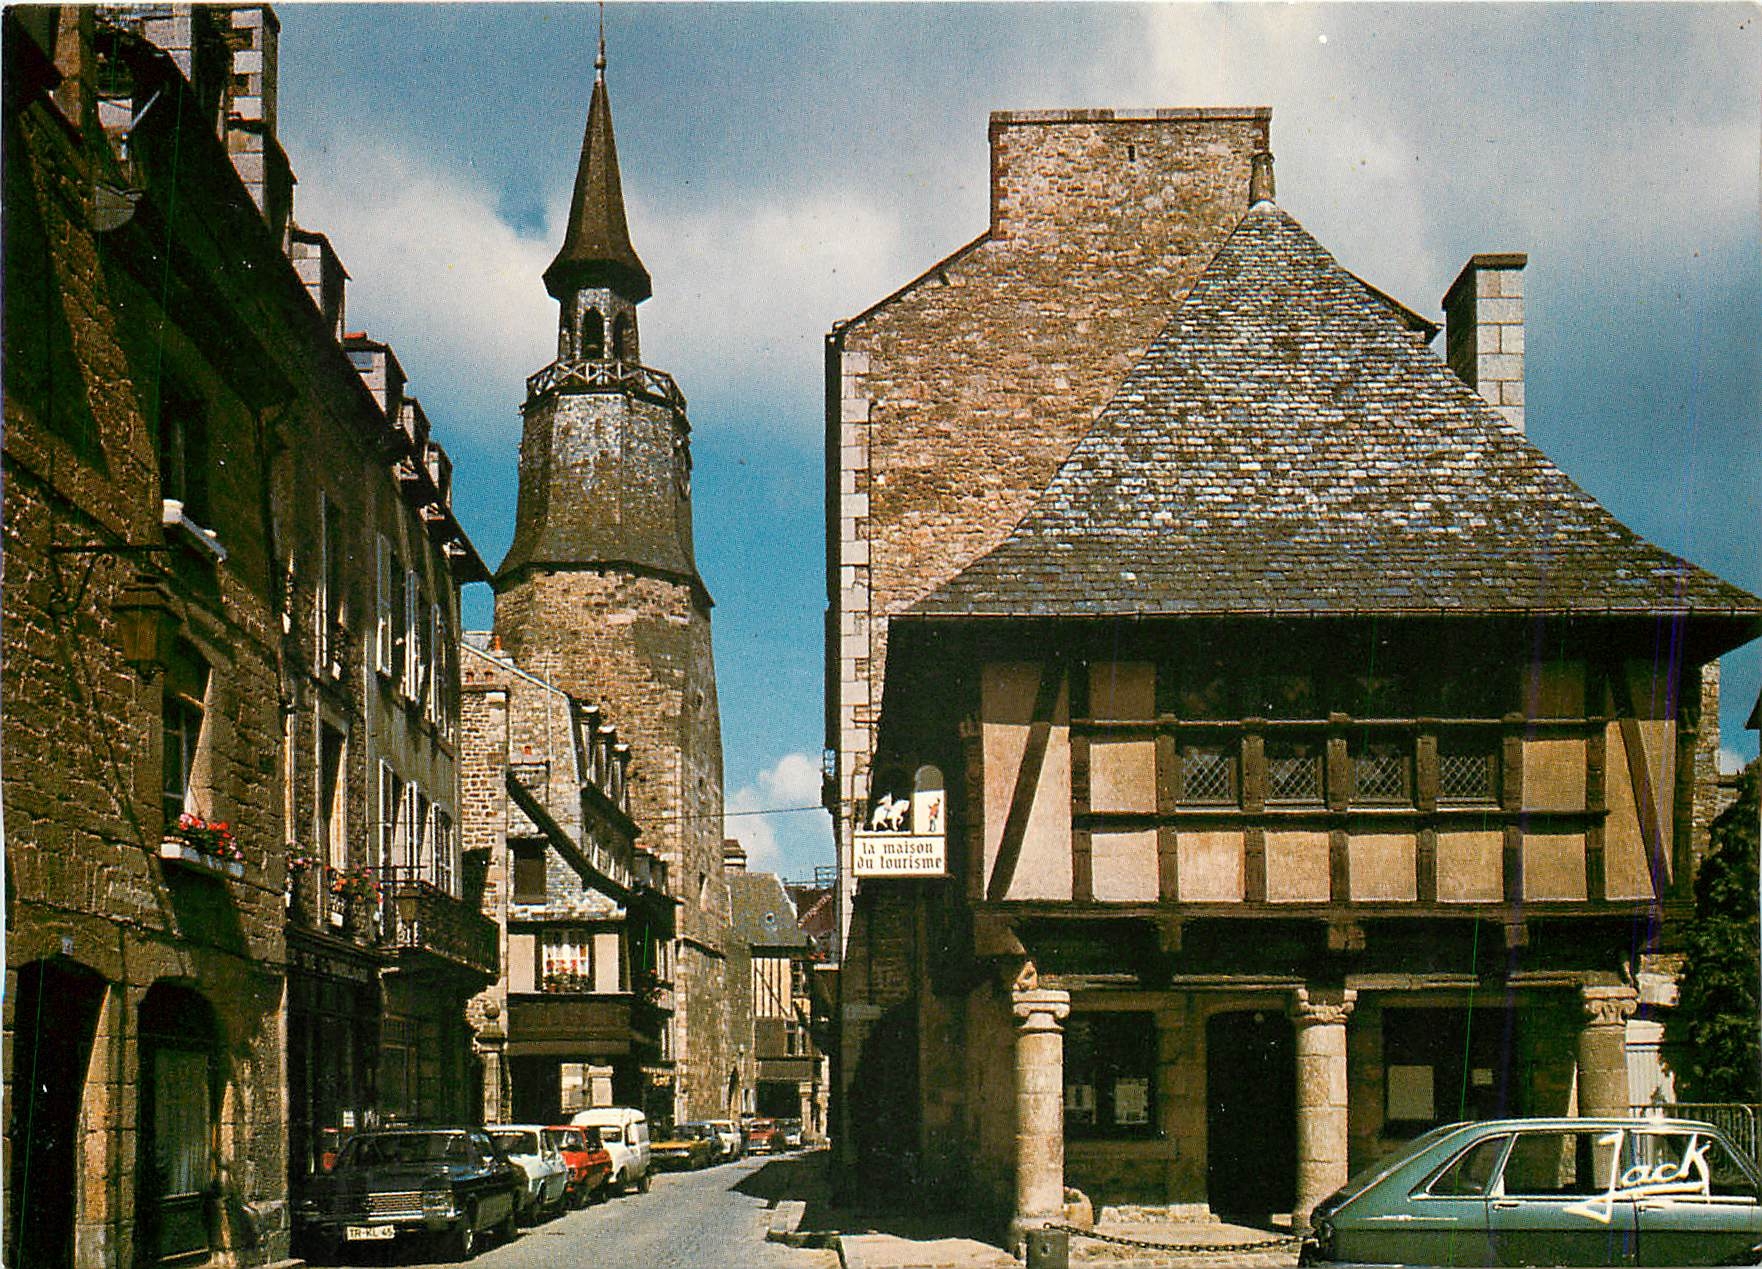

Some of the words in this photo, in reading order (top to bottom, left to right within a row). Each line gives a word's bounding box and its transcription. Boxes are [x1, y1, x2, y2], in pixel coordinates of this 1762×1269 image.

[862, 842, 875, 855] la
[883, 841, 934, 855] maison
[857, 856, 873, 869] du
[880, 855, 942, 869] tourisme
